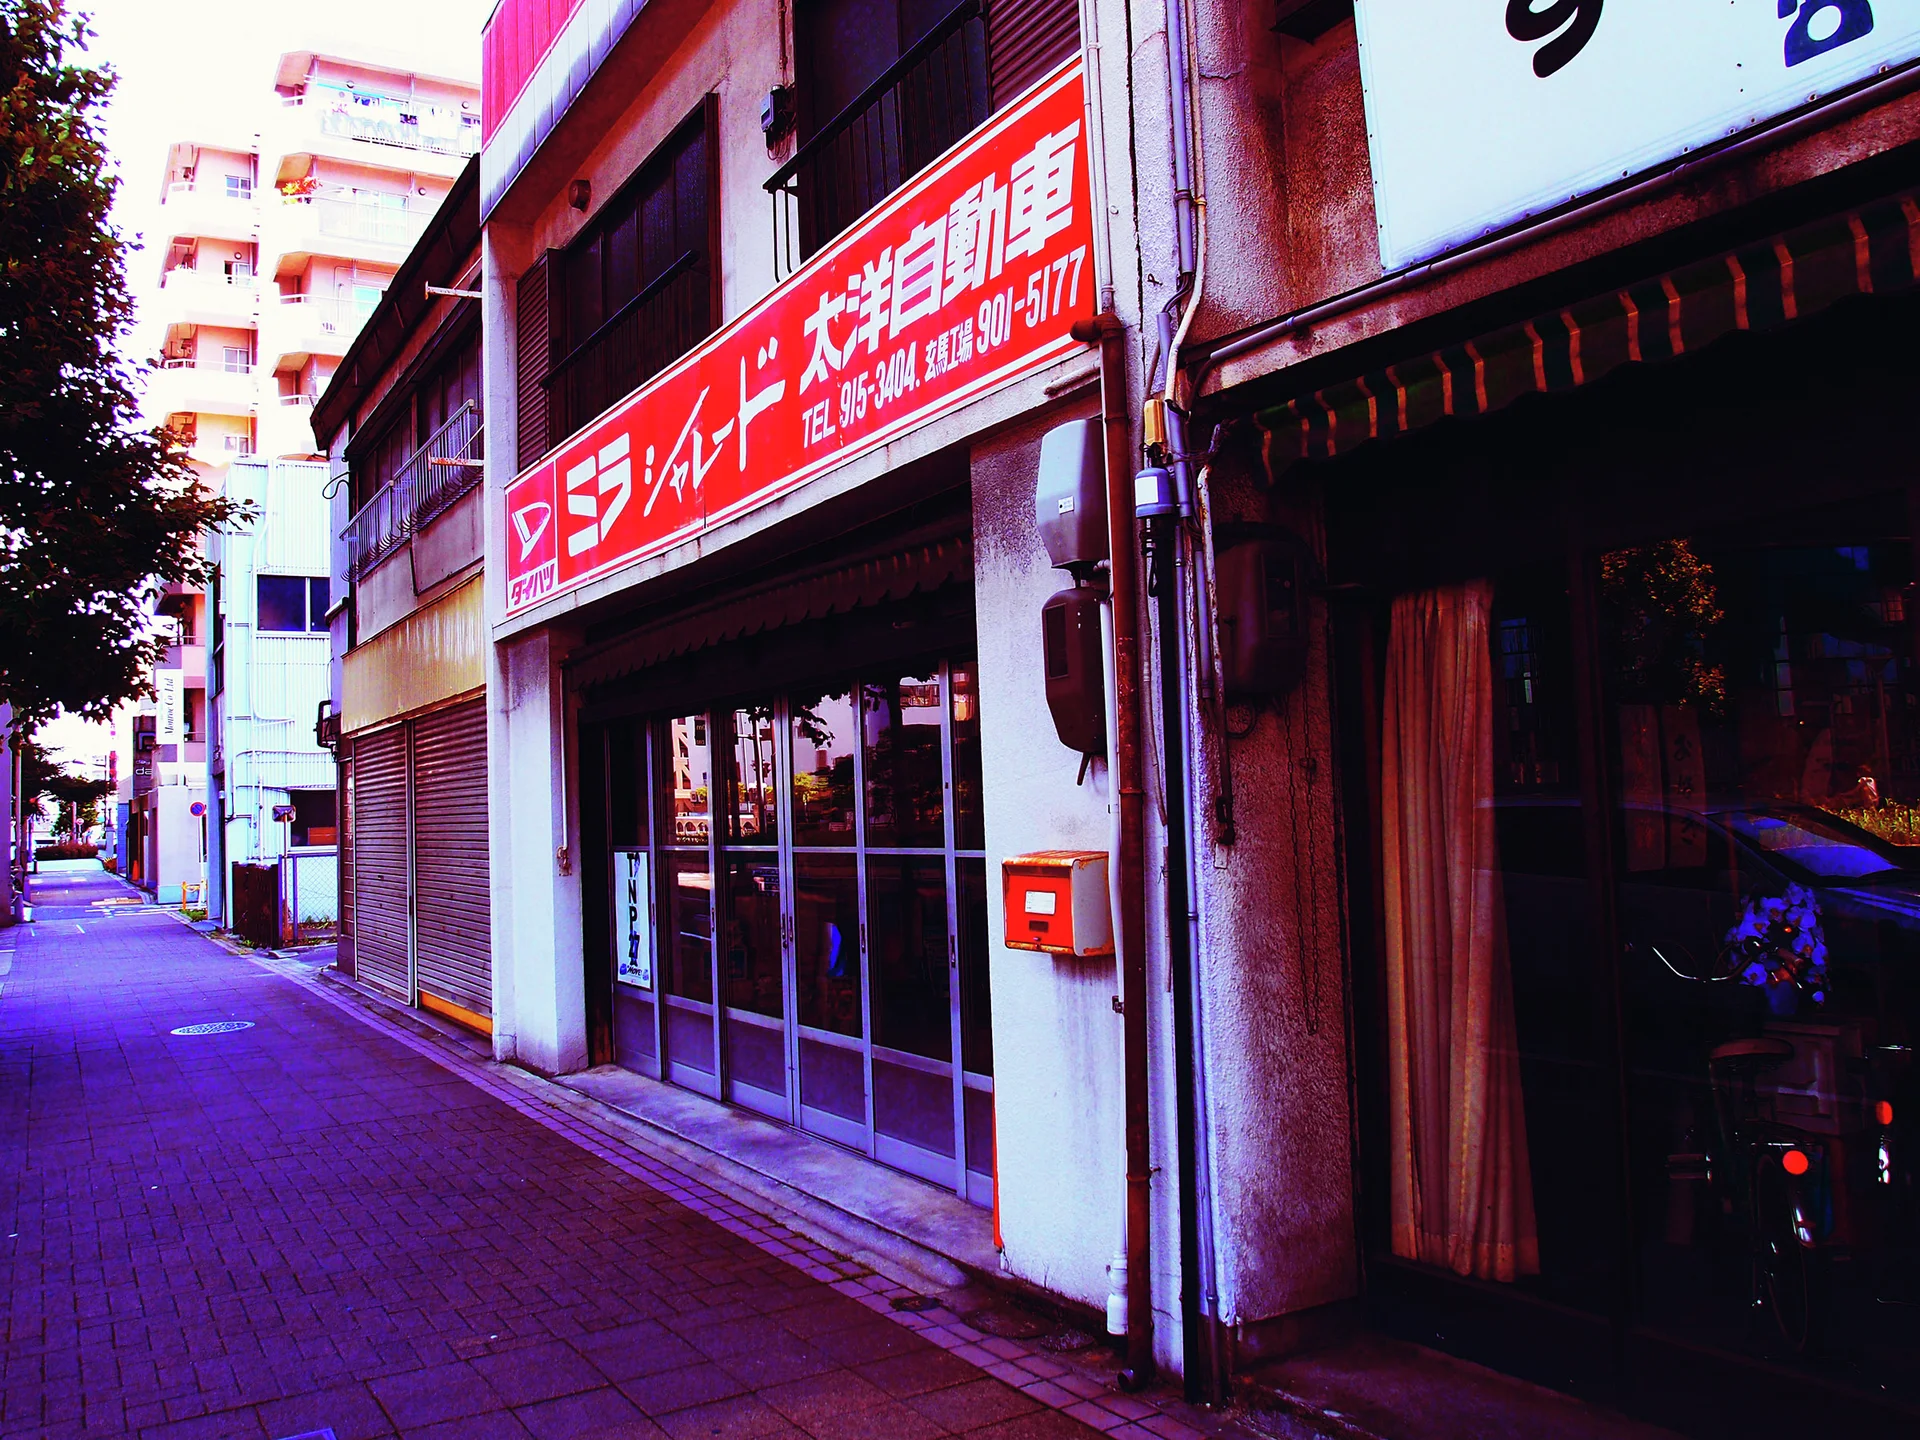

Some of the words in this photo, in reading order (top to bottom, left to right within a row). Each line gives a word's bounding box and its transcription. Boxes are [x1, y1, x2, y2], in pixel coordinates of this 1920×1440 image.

[800, 118, 1081, 396] 太洋自動車
[802, 398, 836, 449] TEL
[976, 244, 1086, 354] 901-5177
[566, 433, 632, 558] ミラ
[643, 336, 786, 517] シャレード
[511, 563, 555, 606] ダイハツ
